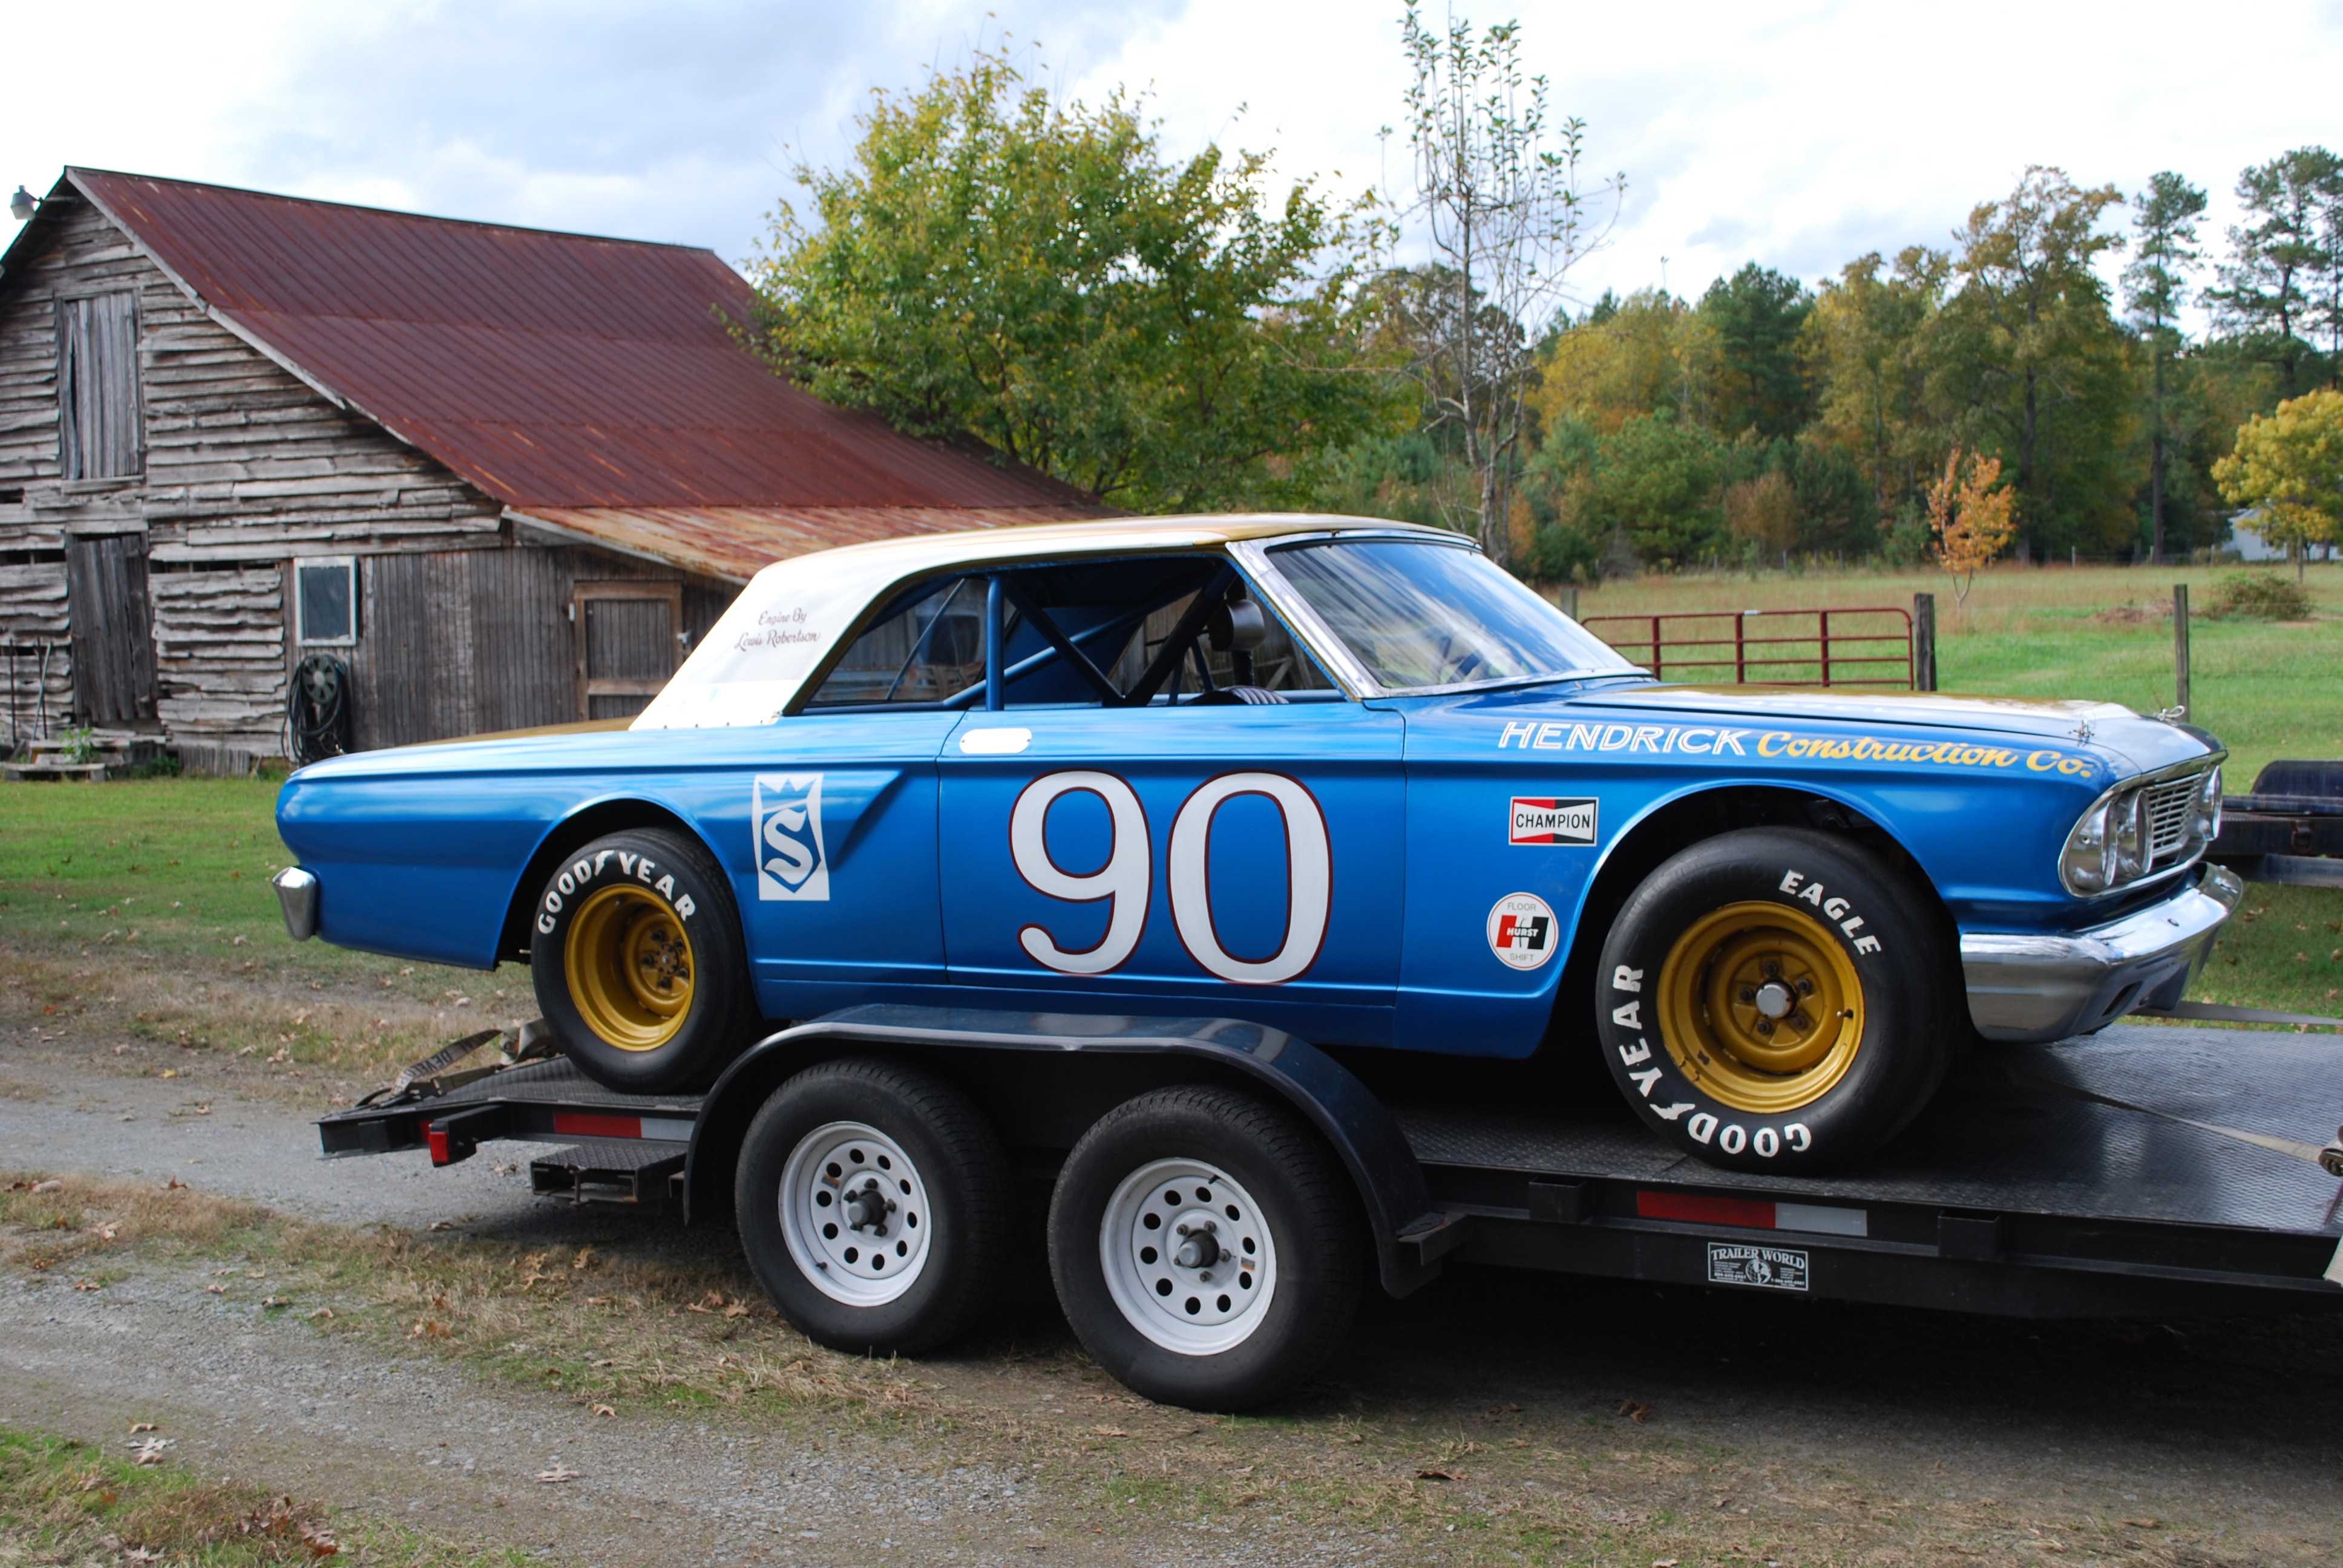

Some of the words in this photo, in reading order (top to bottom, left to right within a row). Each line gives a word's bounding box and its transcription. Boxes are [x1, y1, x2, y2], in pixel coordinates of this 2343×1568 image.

[758, 610, 790, 626] Engine
[792, 607, 807, 623] By
[734, 632, 762, 652] Lewis
[767, 629, 821, 648] Robertson
[1498, 721, 1754, 756] HENDRICK
[1757, 731, 2019, 768] Construction
[2025, 749, 2094, 779] Co.
[1516, 814, 1590, 828] CHAMPION
[1008, 767, 1334, 987] 90
[1507, 902, 1536, 911] FLOOR
[1778, 869, 1882, 955] EAGLE
[1506, 927, 1539, 937] HURST
[1510, 953, 1535, 962] SHIFT
[1711, 1247, 1760, 1261] TRAILER
[1761, 1249, 1805, 1269] WORLD
